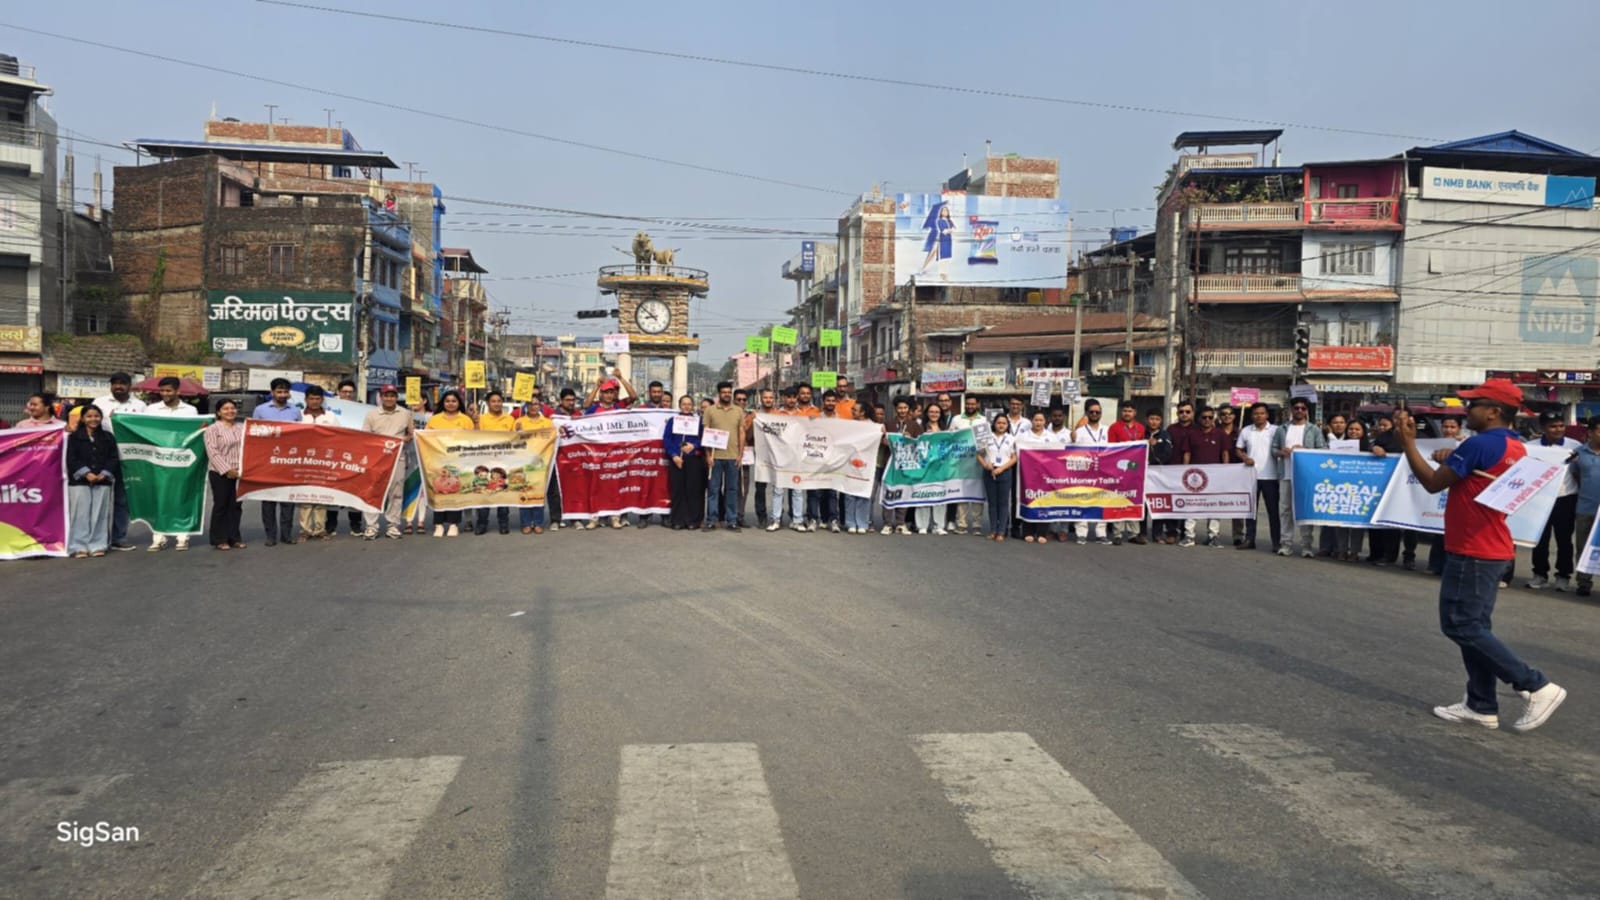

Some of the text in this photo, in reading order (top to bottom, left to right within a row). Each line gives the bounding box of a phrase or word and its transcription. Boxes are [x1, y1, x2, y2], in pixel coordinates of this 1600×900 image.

[1443, 178, 1492, 190] NMB BANK
[1527, 310, 1585, 334] NMB
[607, 421, 625, 430] IME
[627, 420, 649, 429] Bank
[803, 442, 828, 451] Moey
[270, 455, 366, 474] Smart Money Talks
[1070, 477, 1097, 486] Money
[0, 484, 43, 504] lks
[1314, 482, 1381, 496] GLOBAL
[1147, 497, 1171, 509] HBL
[1313, 493, 1375, 506] MONEY
